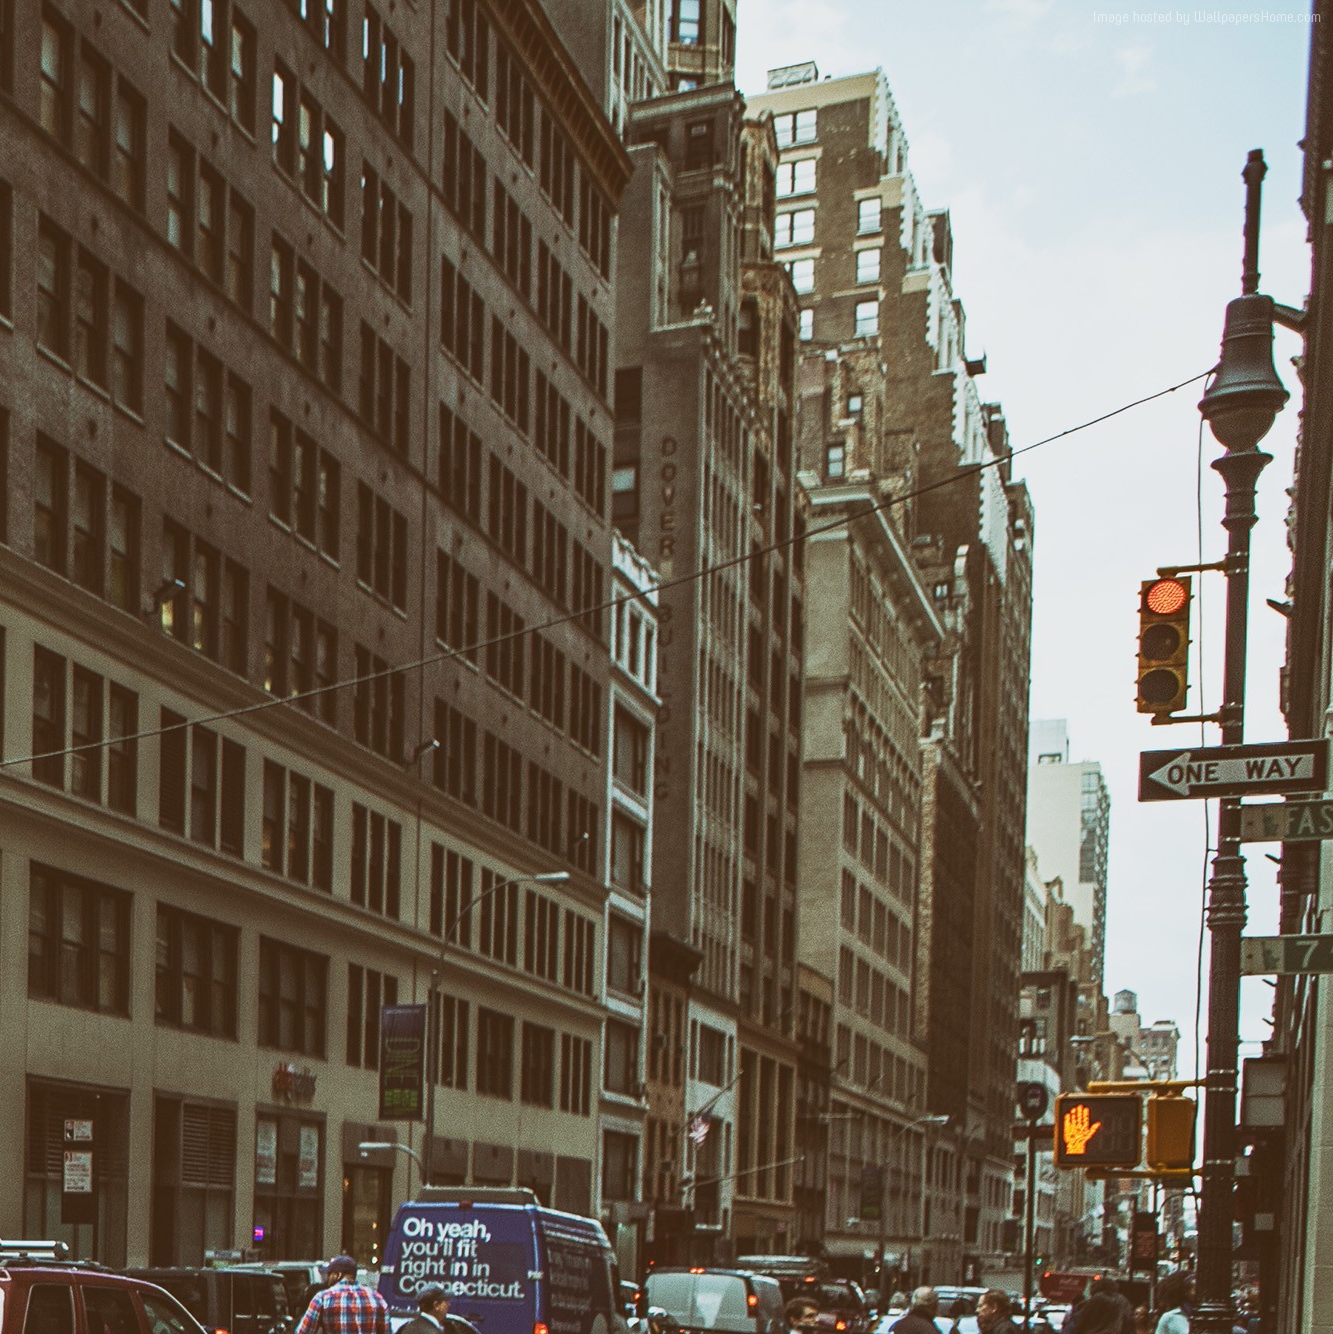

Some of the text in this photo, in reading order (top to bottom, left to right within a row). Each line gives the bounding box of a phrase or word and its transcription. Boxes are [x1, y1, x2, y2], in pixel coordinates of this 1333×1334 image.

[1167, 756, 1304, 785] ONE WAY
[1295, 940, 1320, 969] 7
[402, 1216, 491, 1242] Oh yeah,
[401, 1238, 478, 1259] you'll fit
[400, 1256, 446, 1278] right
[450, 1259, 468, 1277] in
[472, 1259, 490, 1278] in
